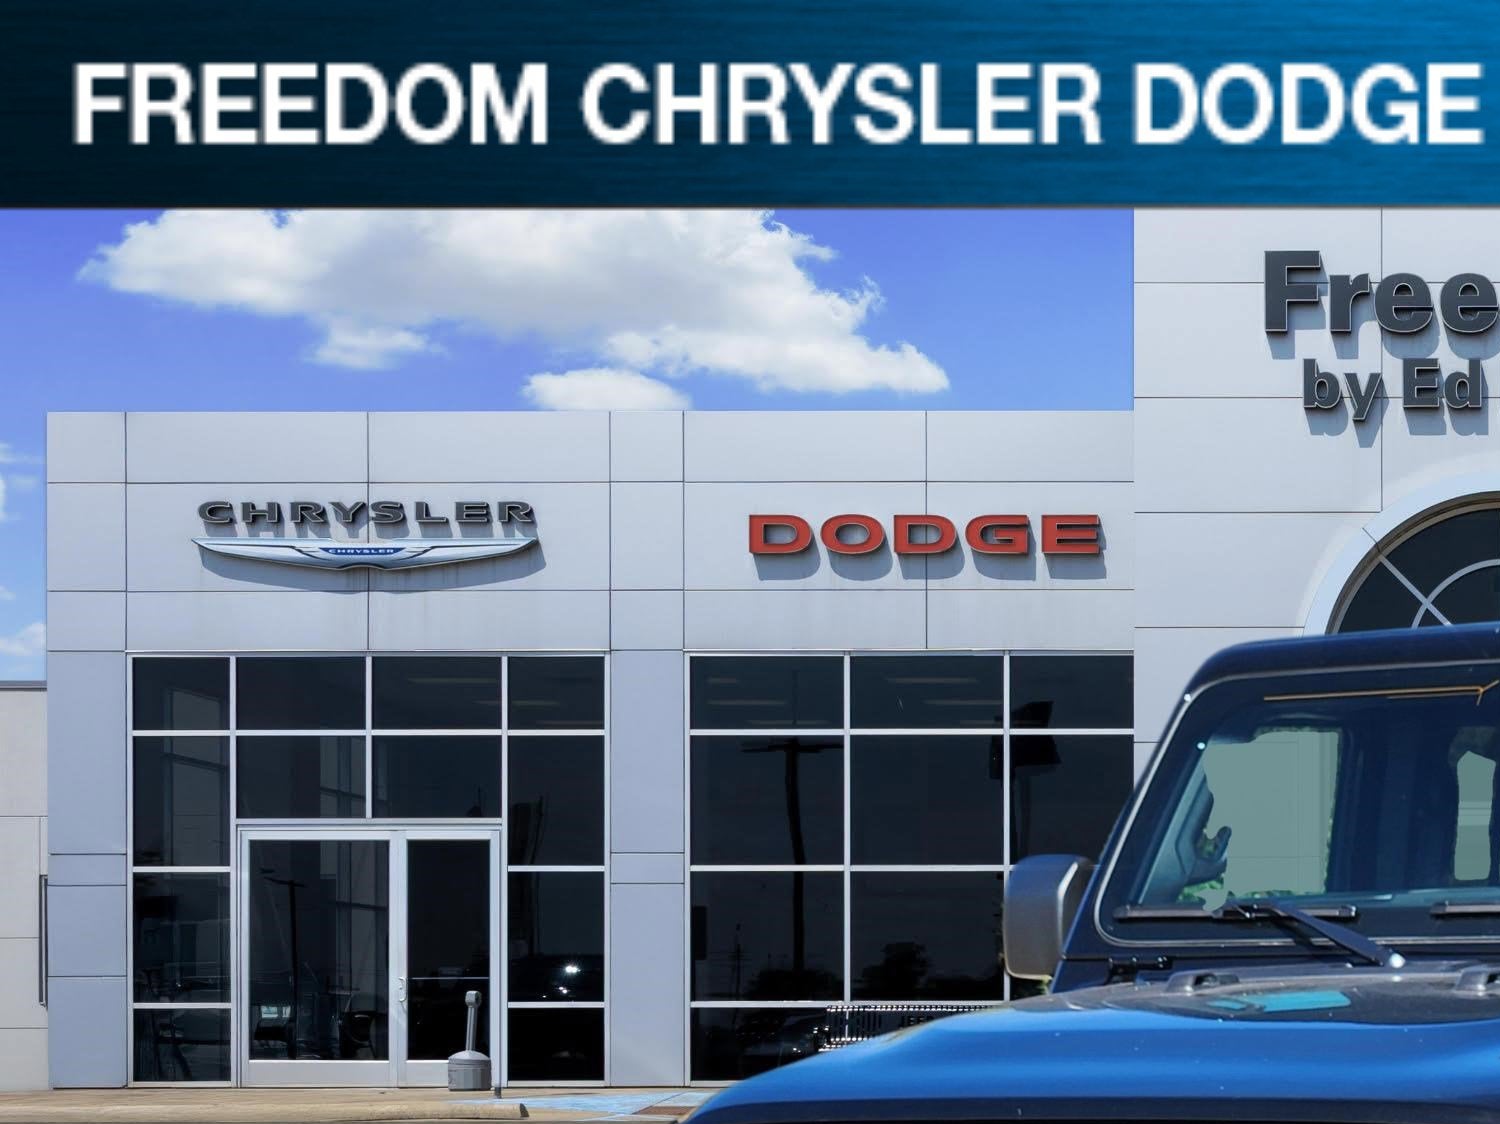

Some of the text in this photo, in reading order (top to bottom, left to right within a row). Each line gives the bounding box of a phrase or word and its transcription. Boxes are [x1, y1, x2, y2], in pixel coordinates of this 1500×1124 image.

[1303, 358, 1383, 421] by
[1402, 358, 1482, 409] Ed
[198, 500, 536, 524] CHRYSLER
[748, 513, 1101, 555] DODGE
